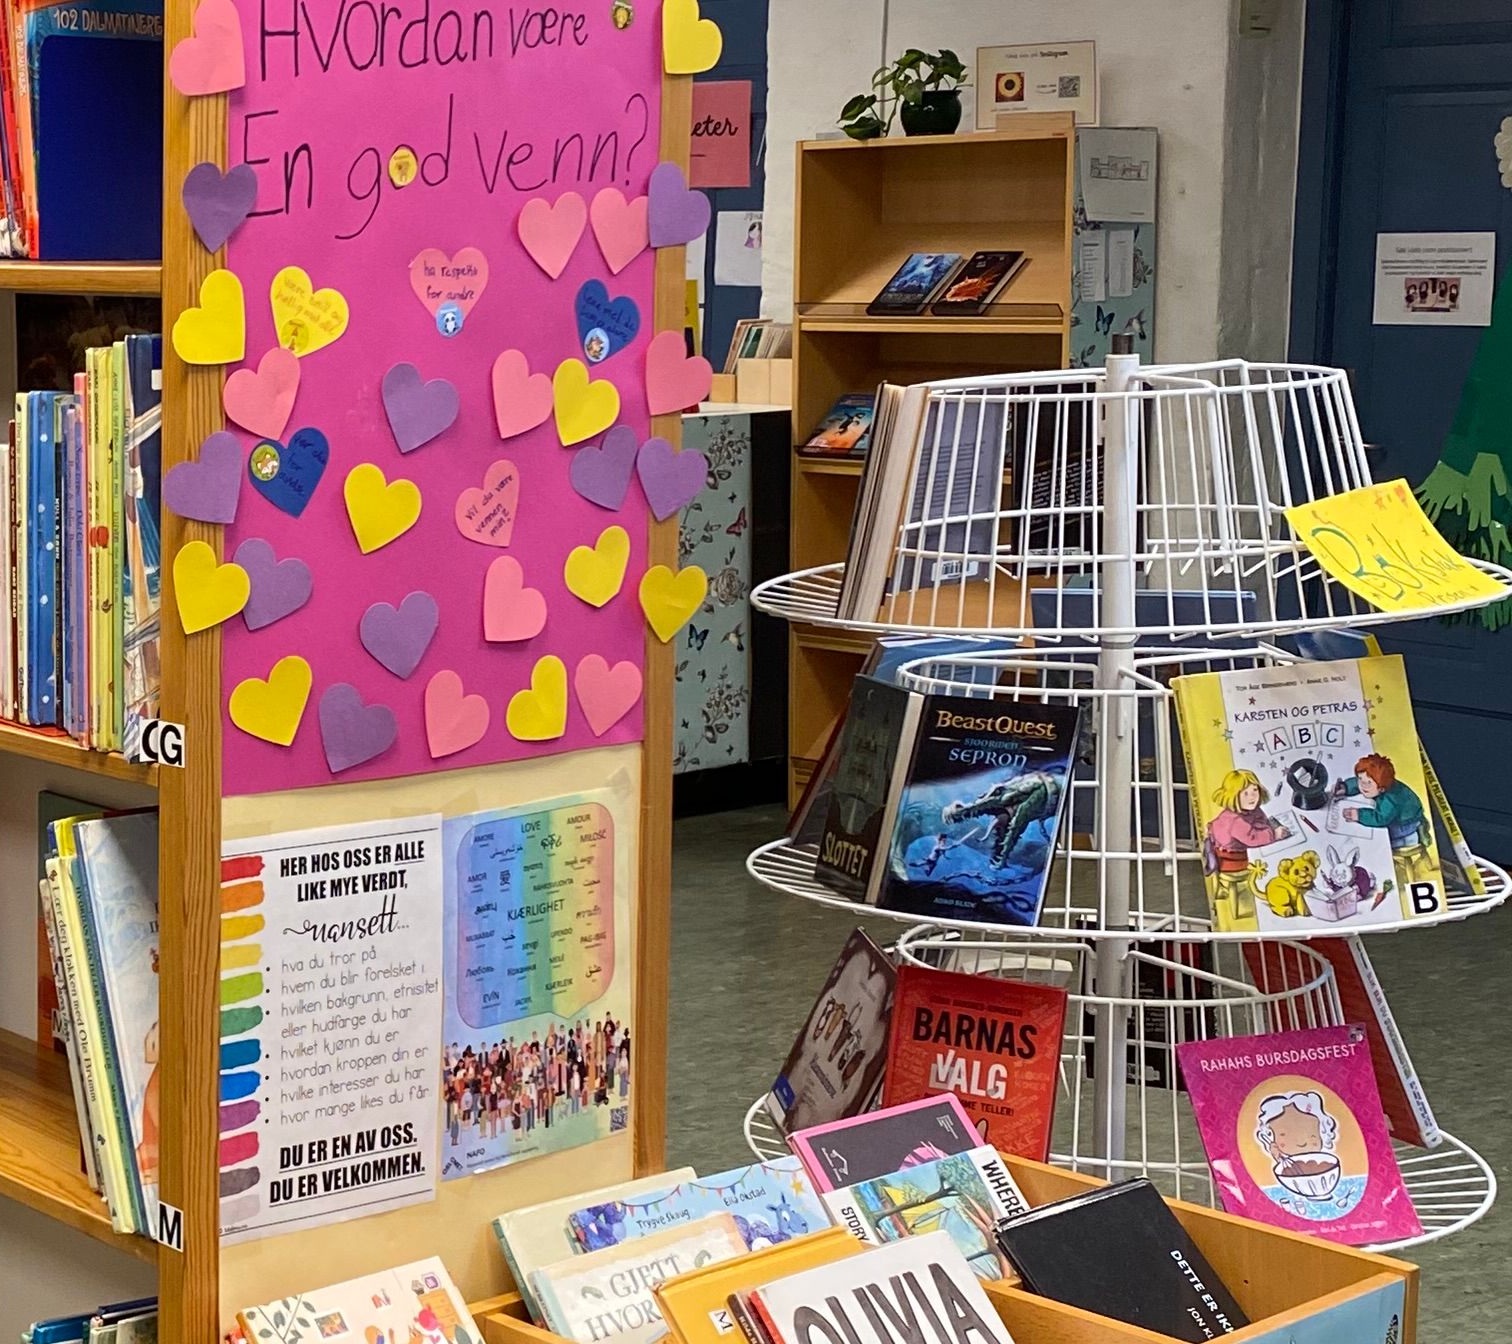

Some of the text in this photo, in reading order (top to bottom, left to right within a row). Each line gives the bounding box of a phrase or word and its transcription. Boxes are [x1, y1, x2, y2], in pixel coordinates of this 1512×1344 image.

[54, 8, 78, 31] 102
[510, 7, 589, 58] være
[244, 94, 650, 240] En gd venn?
[1234, 701, 1358, 724] KARSTEN OG PETRAS
[159, 723, 183, 766] G
[1272, 727, 1339, 750] A B C
[948, 747, 1027, 768] SEPRON
[521, 820, 541, 834] LOVE
[280, 840, 425, 877] HER HOS OSS ER ALLE
[824, 831, 869, 878] SLOTTET
[297, 870, 408, 902] LIKE MYE VERDT,
[1411, 881, 1439, 915] B
[507, 898, 565, 921] KJÆRLIGHET
[63, 946, 78, 1000] klokken
[281, 945, 377, 974] hva du tror på
[281, 960, 416, 995] hvem du blir forelsket
[281, 999, 322, 1017] hvilken
[393, 978, 439, 999] etnisitet
[281, 1006, 412, 1039] eller hudfarge du har
[912, 1007, 1037, 1060] BARNAS
[280, 1029, 399, 1061] hvilket kjønn du er
[1200, 1044, 1357, 1073] RAHAHS BURSDAGSFEST
[280, 1046, 429, 1082] hvordan kroppen din er
[935, 1049, 1008, 1100] VALG
[280, 1066, 425, 1104] hvilke interesser du har
[280, 1109, 310, 1126] hvor
[315, 1100, 356, 1117] mange
[360, 1094, 384, 1109] likes
[388, 1088, 404, 1104] du
[279, 1122, 418, 1170] DU ER EN AV OSS.
[269, 1151, 426, 1204] DU ER VELKOMMEN.
[980, 1159, 1026, 1218] WHERE
[161, 1204, 181, 1248] M
[841, 1206, 869, 1241] STORY
[609, 1252, 682, 1299] GJETT
[1170, 1249, 1206, 1292] DETTE
[1201, 1293, 1219, 1312] ER
[585, 1298, 664, 1342] HVOR
[715, 1309, 733, 1332] M
[1187, 1307, 1206, 1327] JON
